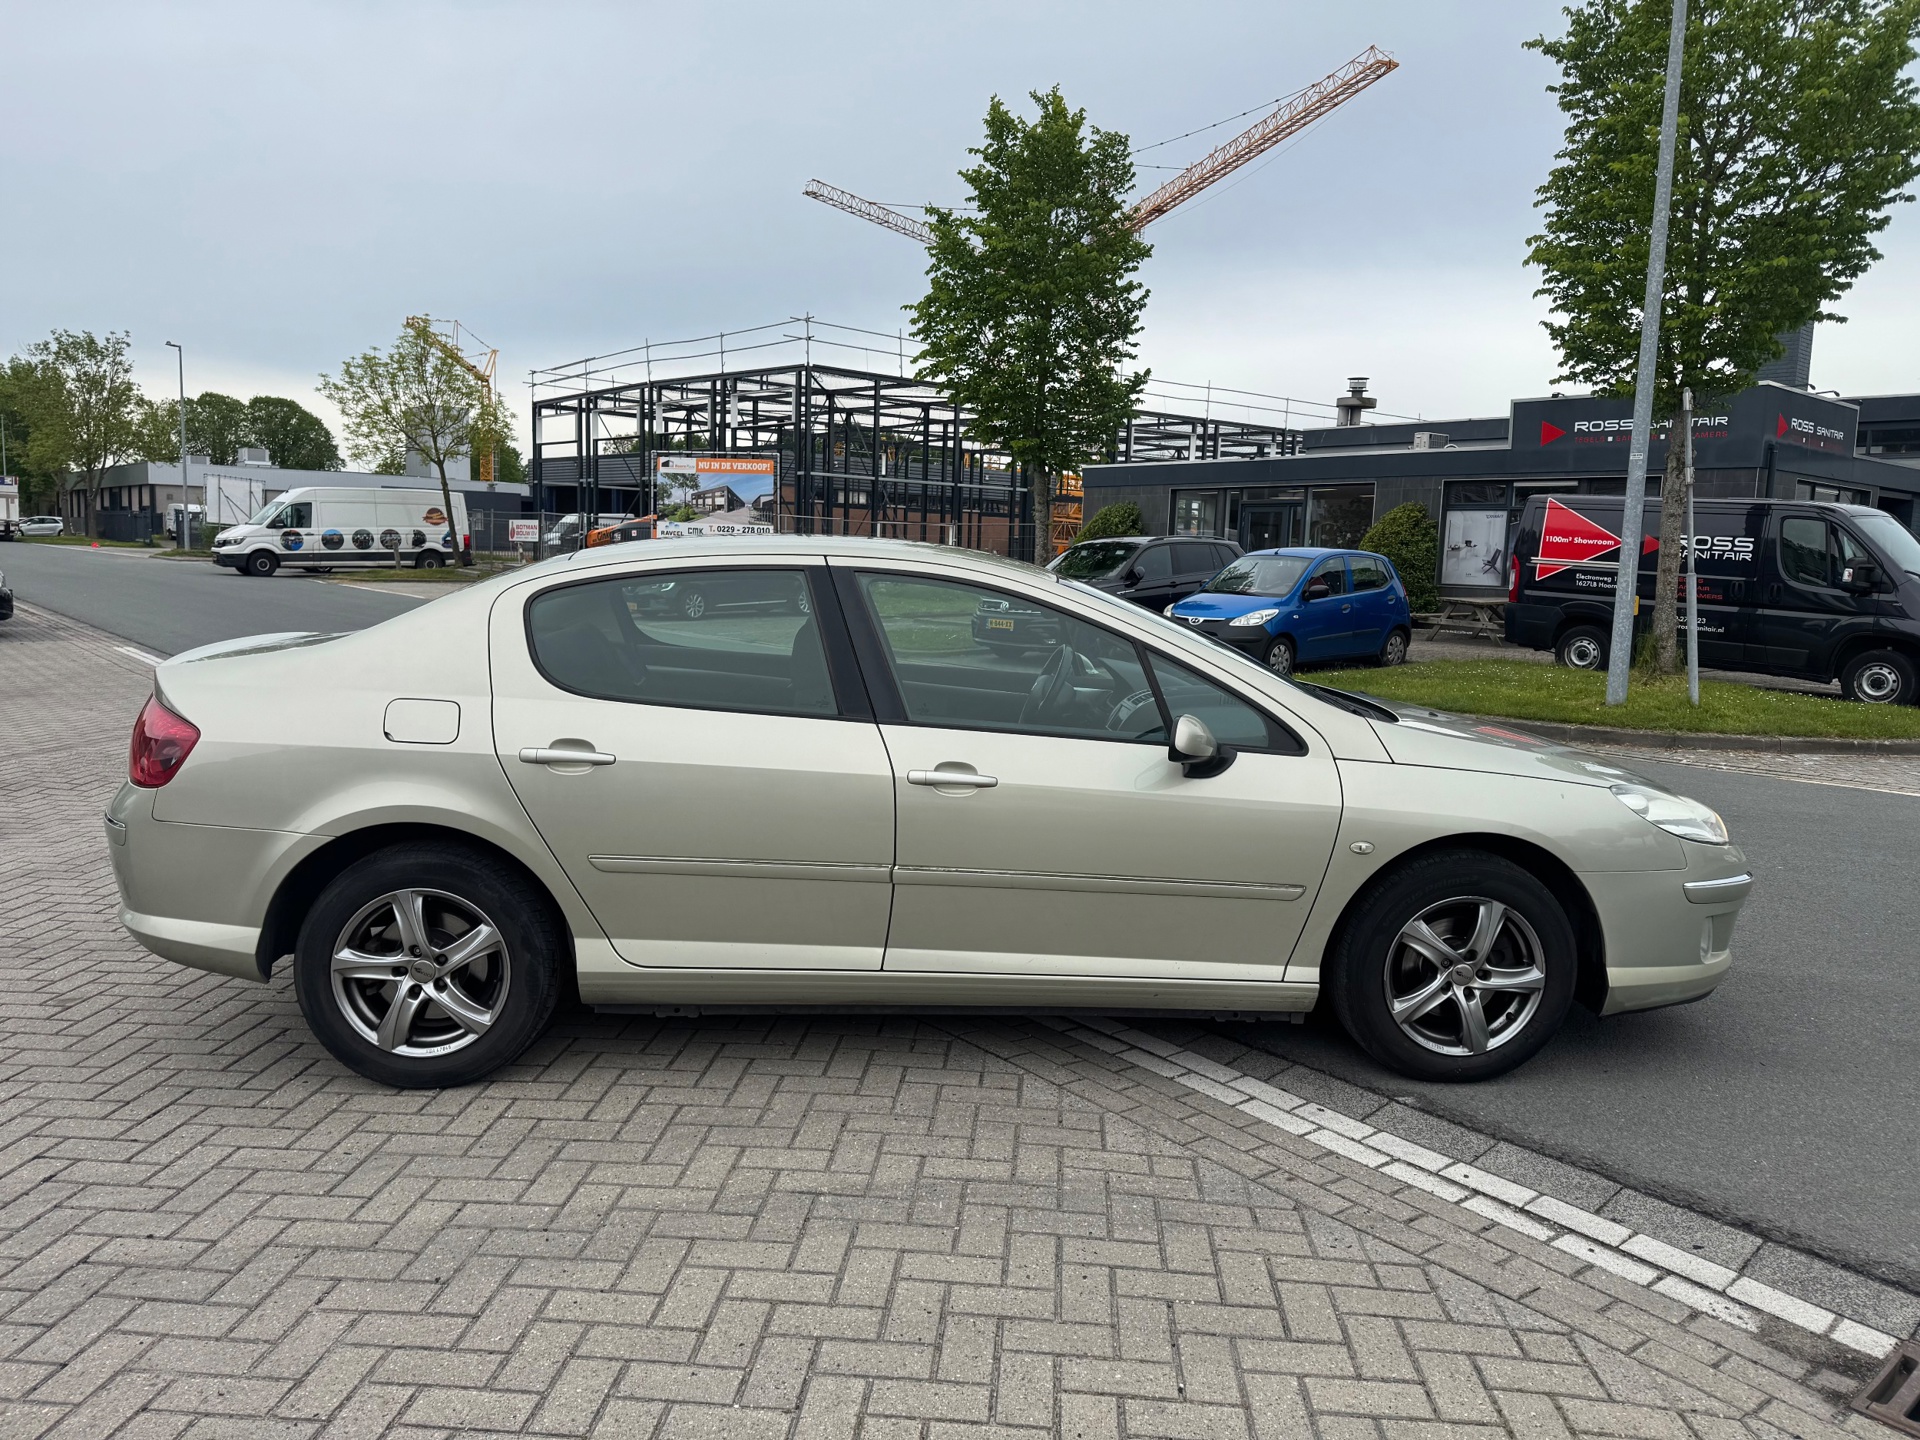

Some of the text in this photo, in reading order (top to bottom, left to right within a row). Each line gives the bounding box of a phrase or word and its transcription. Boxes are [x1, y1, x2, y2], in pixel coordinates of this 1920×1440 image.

[1574, 419, 1634, 432] ROSS
[1791, 418, 1844, 440] ROSS SANITAIR
[711, 462, 720, 470] IN
[721, 462, 731, 470] DE
[732, 463, 770, 471] VERKOOP!
[1574, 537, 1614, 546] Showroom
[1680, 550, 1752, 561] ANITAIR
[1576, 573, 1612, 582] Electronweg
